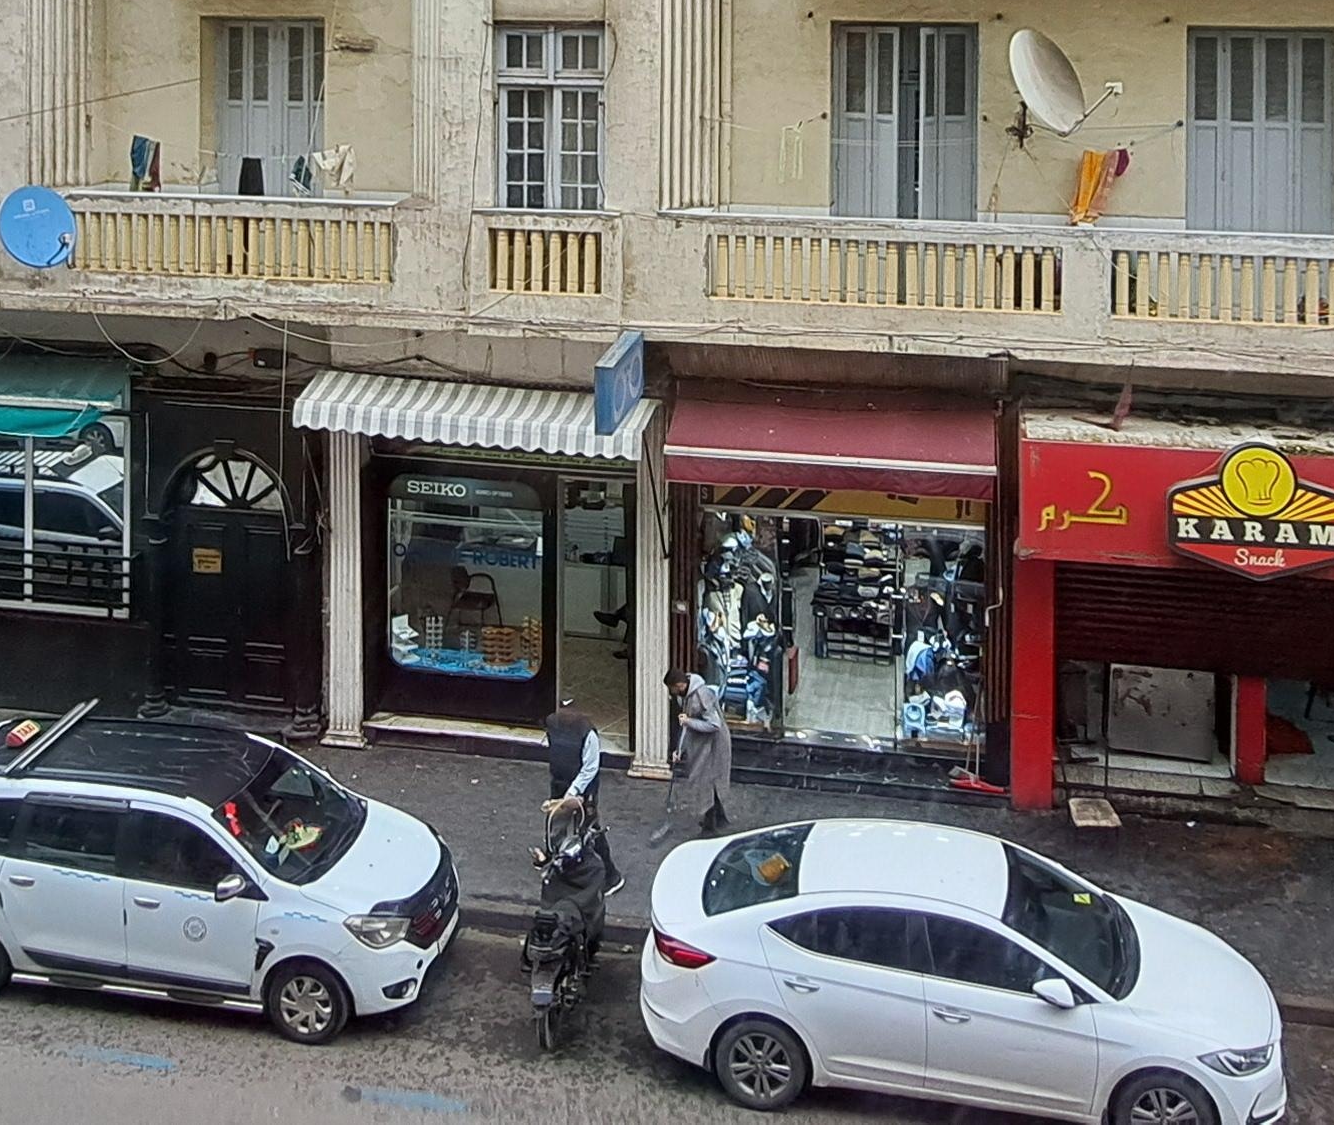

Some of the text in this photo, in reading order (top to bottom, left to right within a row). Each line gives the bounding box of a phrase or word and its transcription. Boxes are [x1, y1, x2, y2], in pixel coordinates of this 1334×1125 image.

[407, 480, 466, 497] SEIKO
[1037, 470, 1128, 532] كرم
[473, 550, 538, 569] ROBERT
[1233, 548, 1286, 568] Snack
